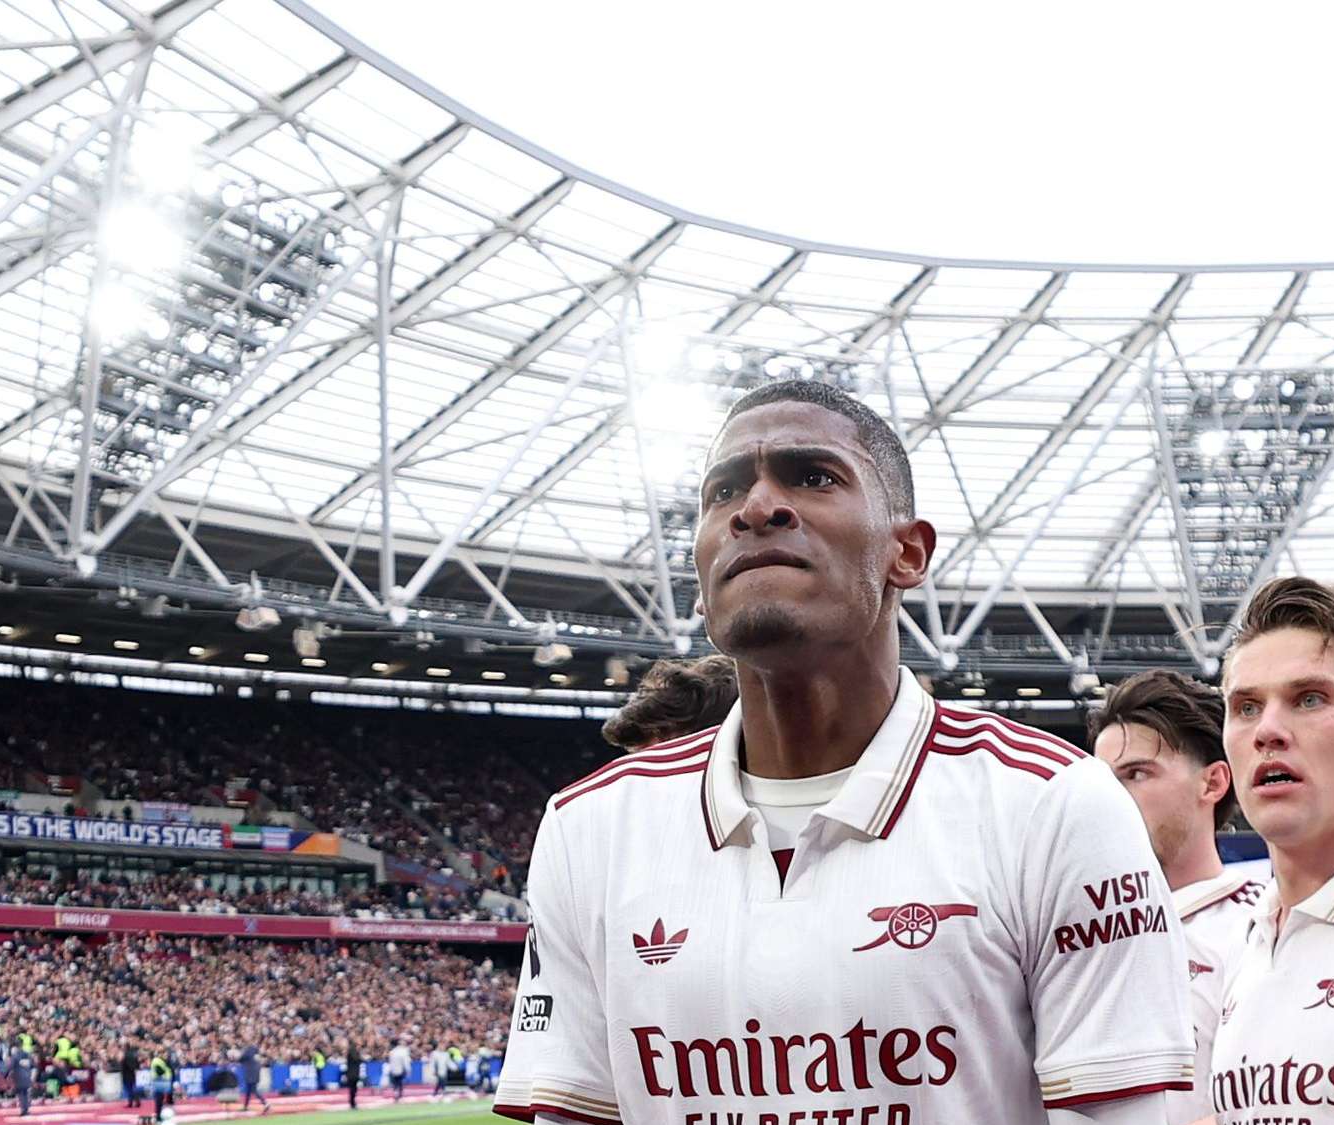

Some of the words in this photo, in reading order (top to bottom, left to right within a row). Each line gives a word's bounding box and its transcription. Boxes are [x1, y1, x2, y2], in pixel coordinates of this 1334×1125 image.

[13, 816, 32, 837] IS
[33, 816, 73, 839] THE
[74, 819, 162, 846] WORLD'S
[162, 824, 223, 848] STAGE
[1084, 870, 1149, 911] VISIT
[1054, 904, 1168, 954] RWANDA
[630, 1017, 957, 1098] Emirates
